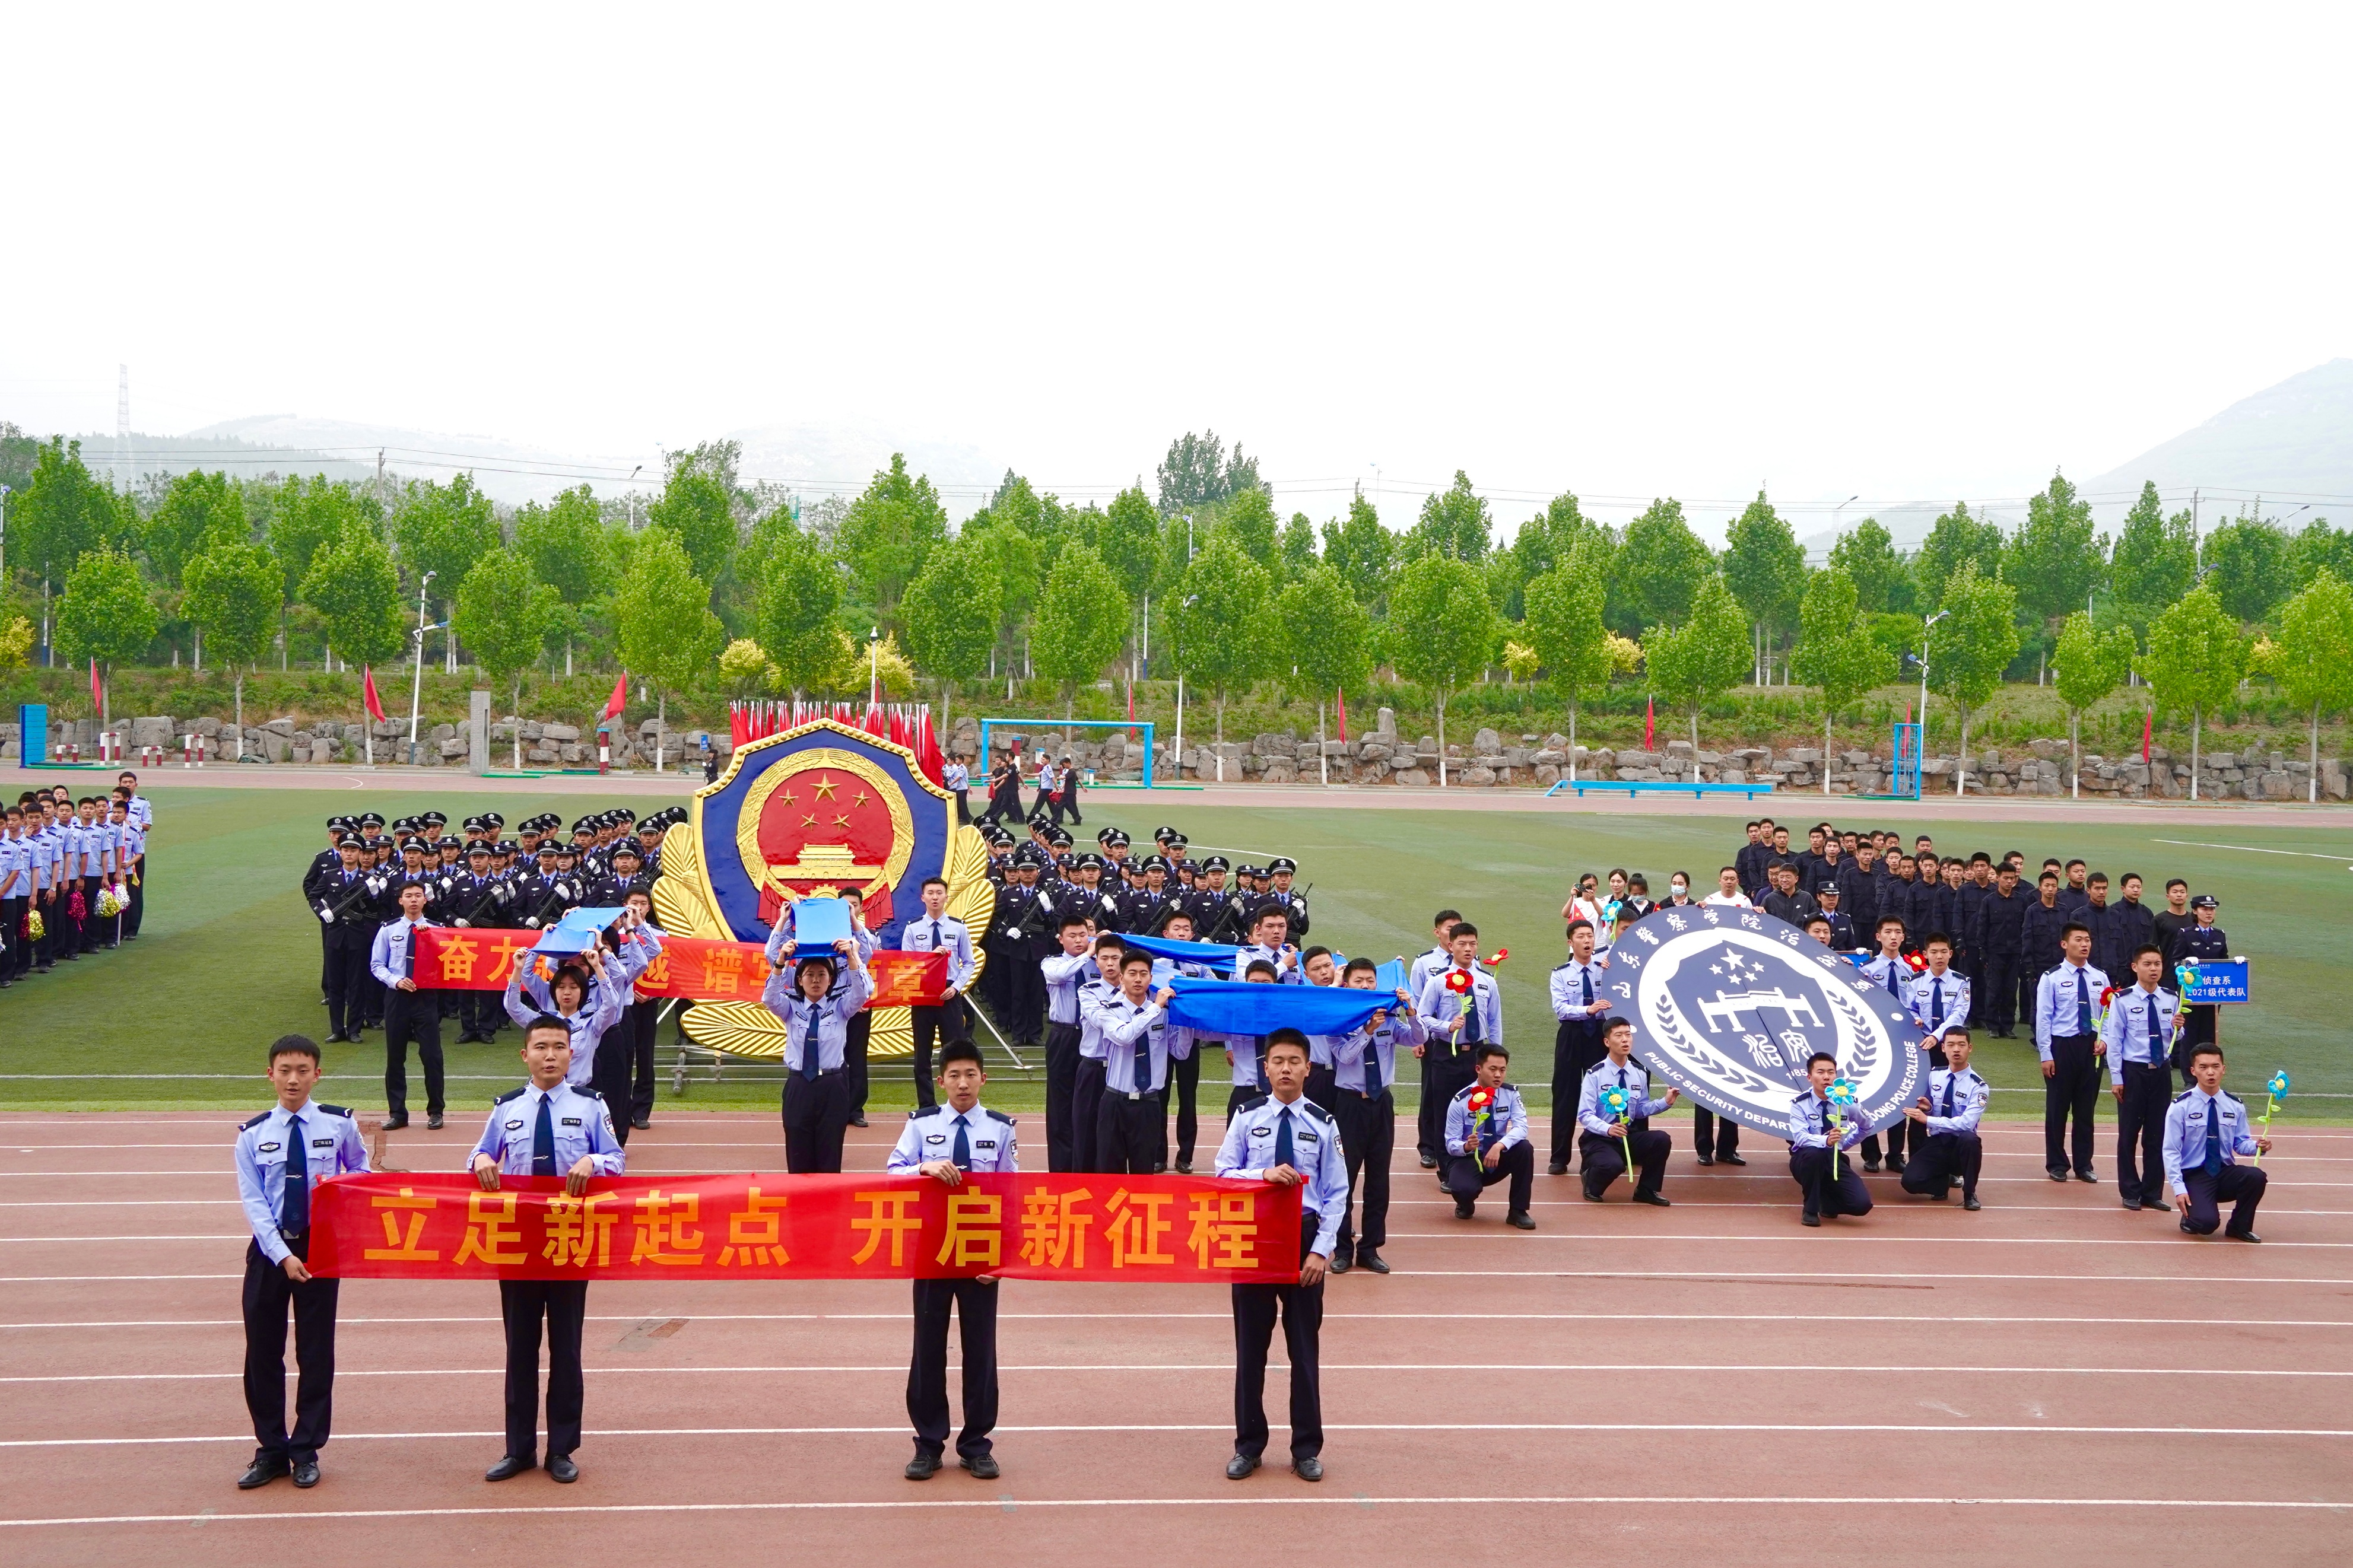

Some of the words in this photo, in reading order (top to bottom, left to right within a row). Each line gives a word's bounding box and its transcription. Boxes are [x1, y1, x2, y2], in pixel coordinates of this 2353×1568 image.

[2187, 987, 2246, 997] 021级代表队
[2202, 975, 2231, 985] 侦查系
[1644, 1051, 1684, 1081] PUBLIC
[1682, 1080, 1744, 1115] SECURITY
[1890, 1077, 1916, 1106] POLICE
[1903, 1041, 1919, 1079] COLLEGE
[364, 1186, 790, 1267] 立足新起点
[850, 1185, 1259, 1270] 开启新征程
